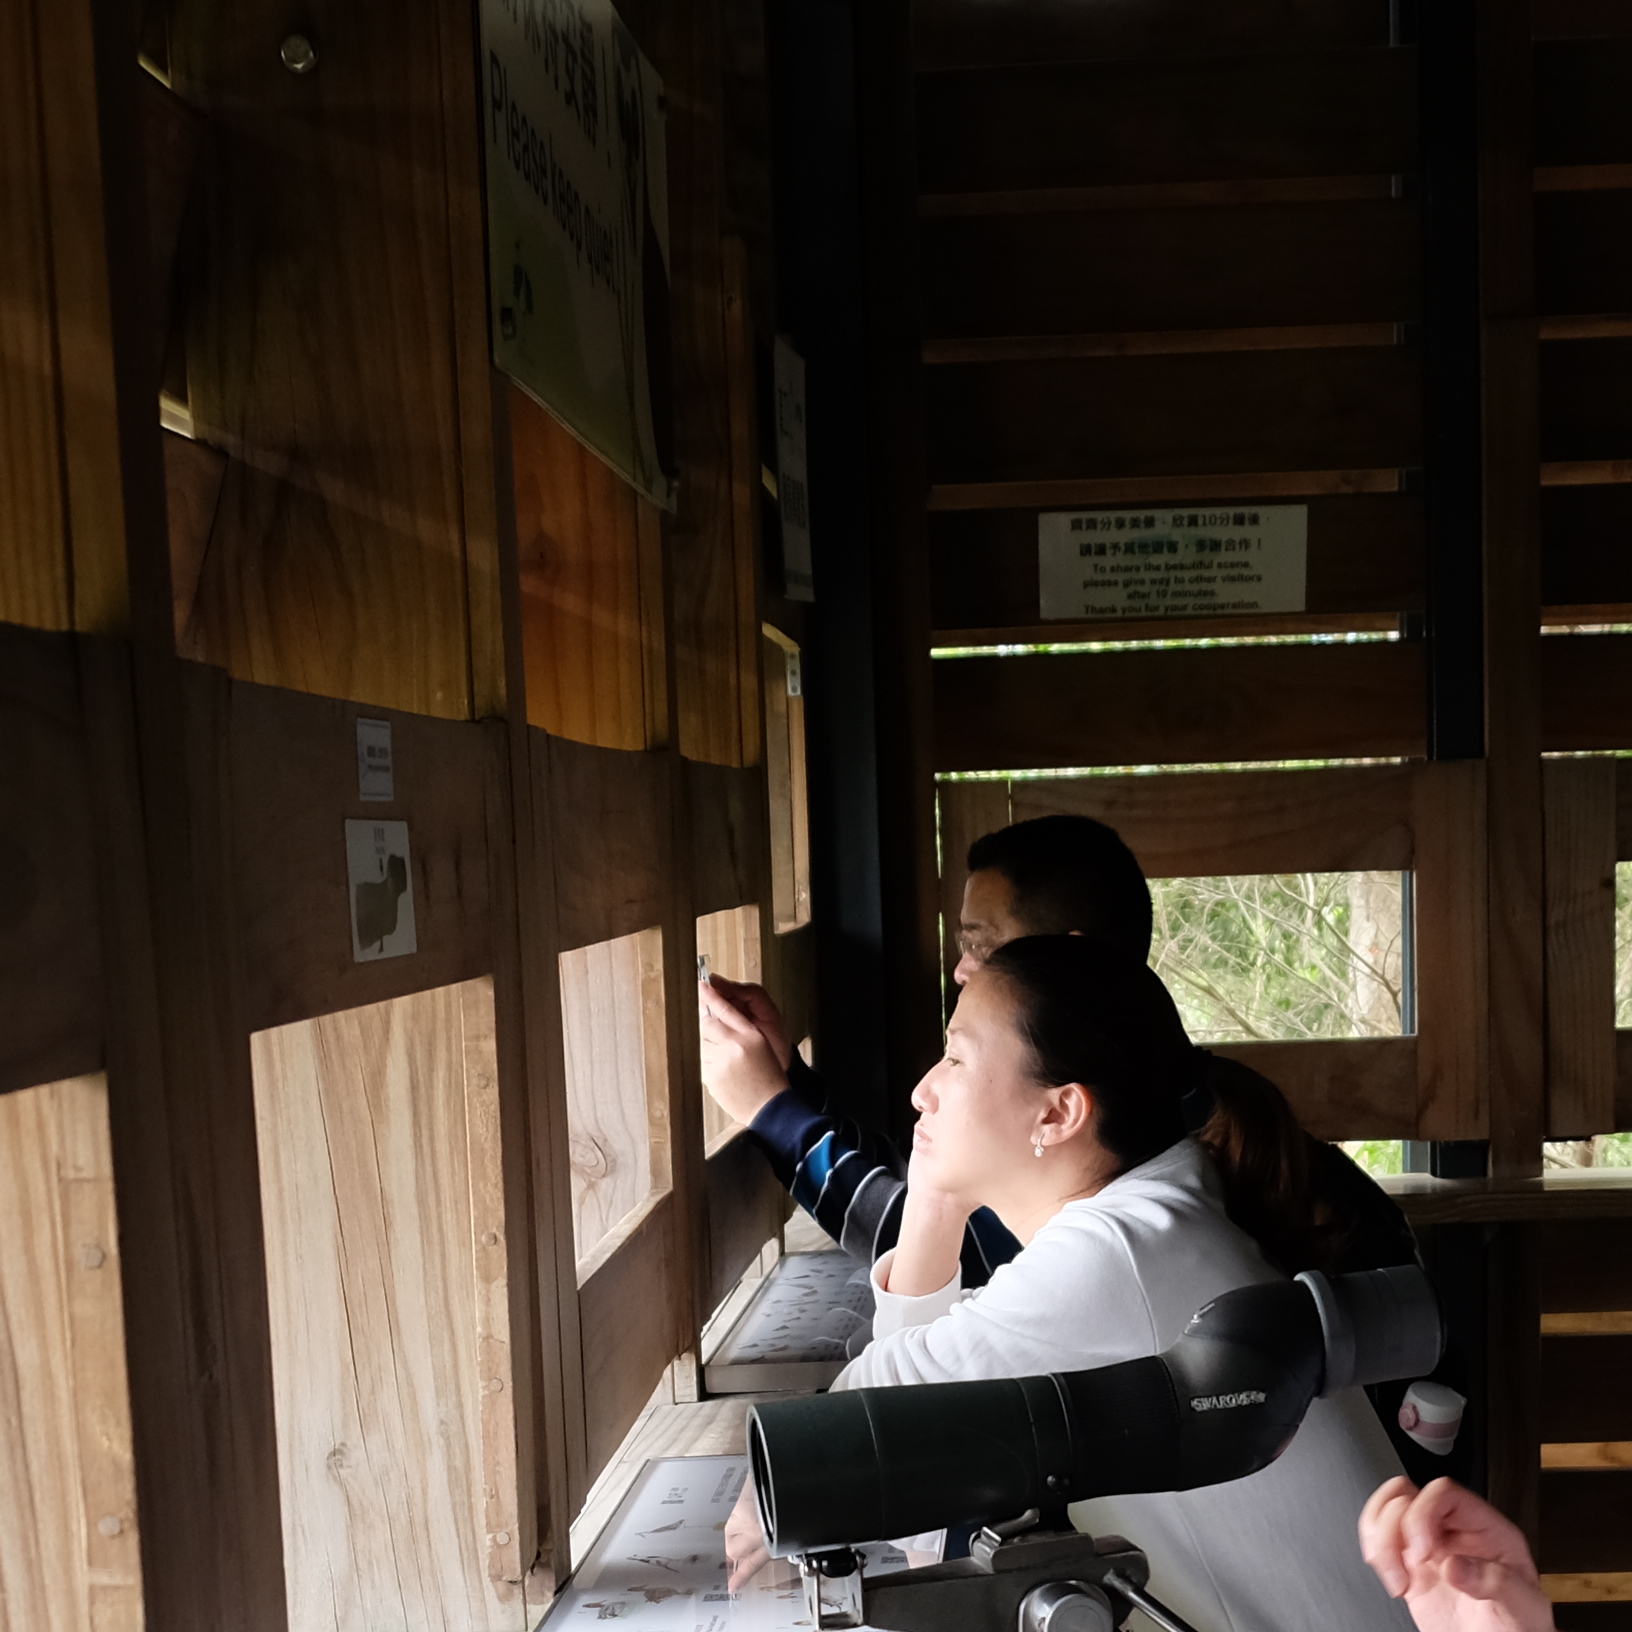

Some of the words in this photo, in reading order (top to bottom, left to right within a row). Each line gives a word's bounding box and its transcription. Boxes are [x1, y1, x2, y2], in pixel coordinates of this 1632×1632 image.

[490, 50, 548, 206] Please
[549, 132, 582, 270] keep
[1093, 564, 1106, 574] To
[1110, 563, 1141, 573] share
[1144, 562, 1161, 572] the
[1164, 560, 1213, 572] beautiful
[1083, 578, 1119, 589] please
[1122, 577, 1145, 589] give
[1149, 577, 1171, 588] way
[1174, 575, 1185, 584] to
[1188, 573, 1217, 584] other
[1220, 572, 1262, 583] visitors
[1126, 589, 1151, 600] after
[1083, 605, 1117, 615] Thank
[1121, 605, 1141, 616] you
[1144, 602, 1159, 612] for
[1164, 603, 1188, 615] your
